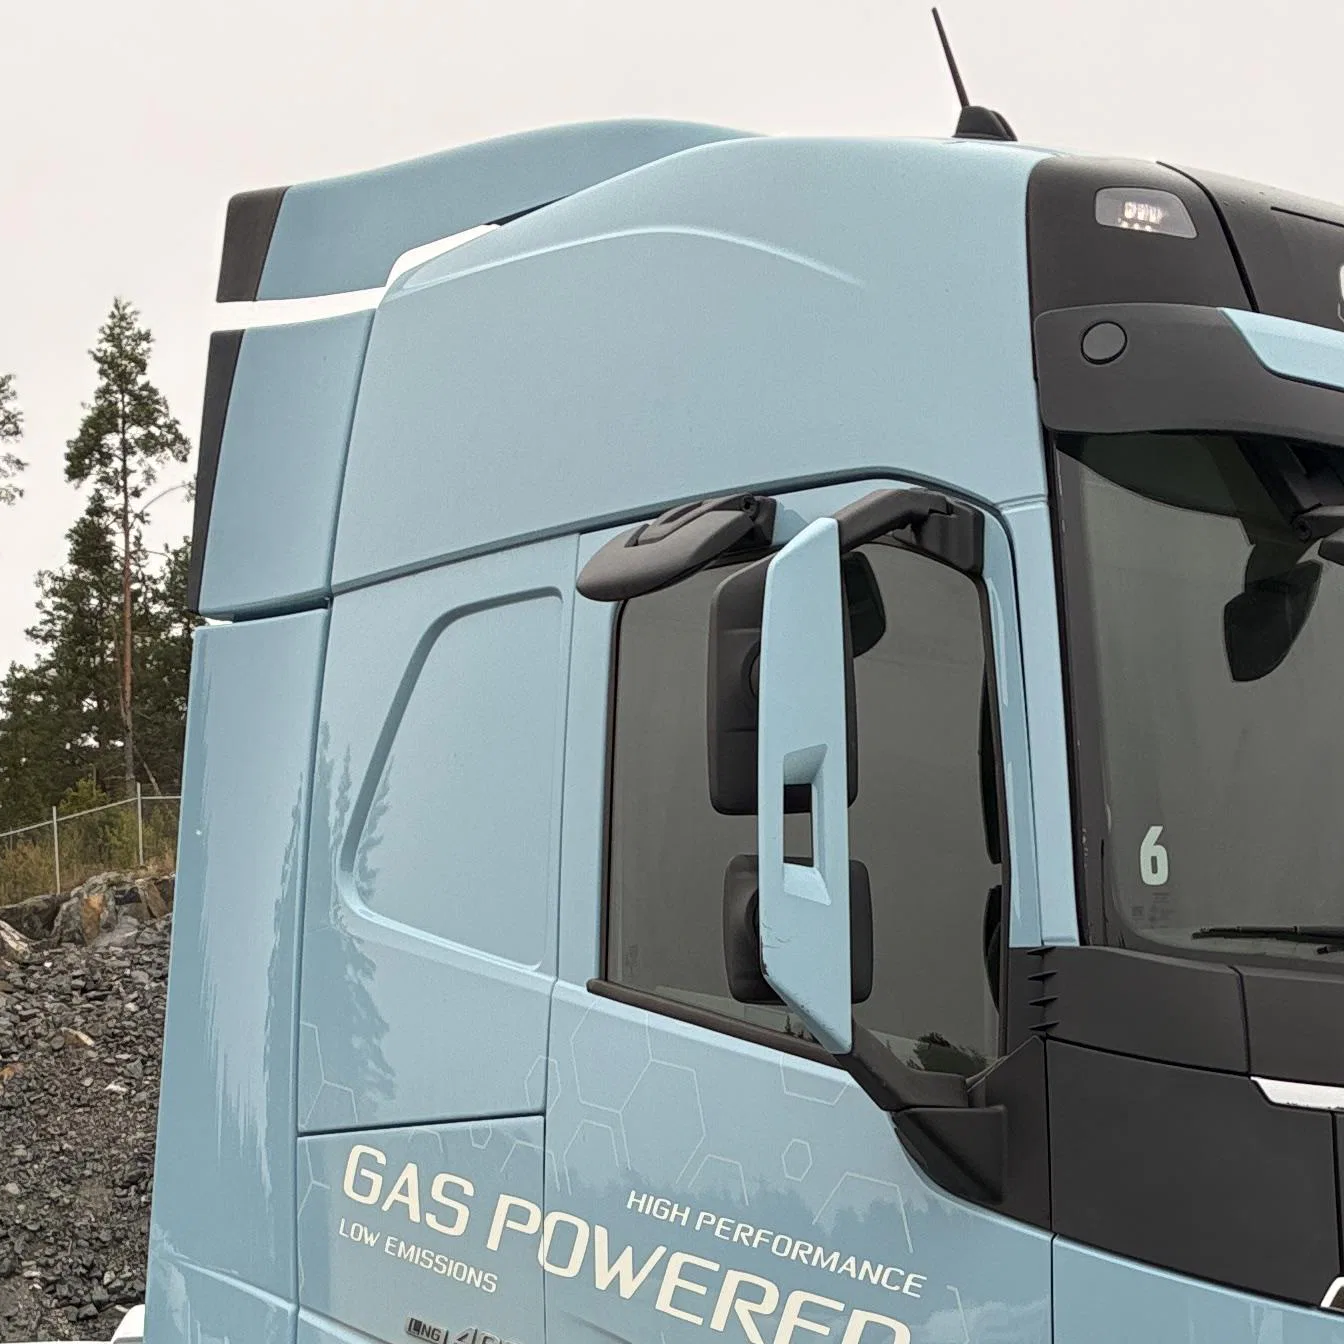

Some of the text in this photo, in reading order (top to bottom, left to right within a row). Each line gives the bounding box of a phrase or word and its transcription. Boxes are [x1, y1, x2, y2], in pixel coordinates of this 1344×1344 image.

[1140, 825, 1169, 886] 6
[342, 1143, 474, 1237] GAS
[338, 1218, 498, 1294] LOW EMISSIONS
[626, 1189, 928, 1299] HIGH PERFORMANCE
